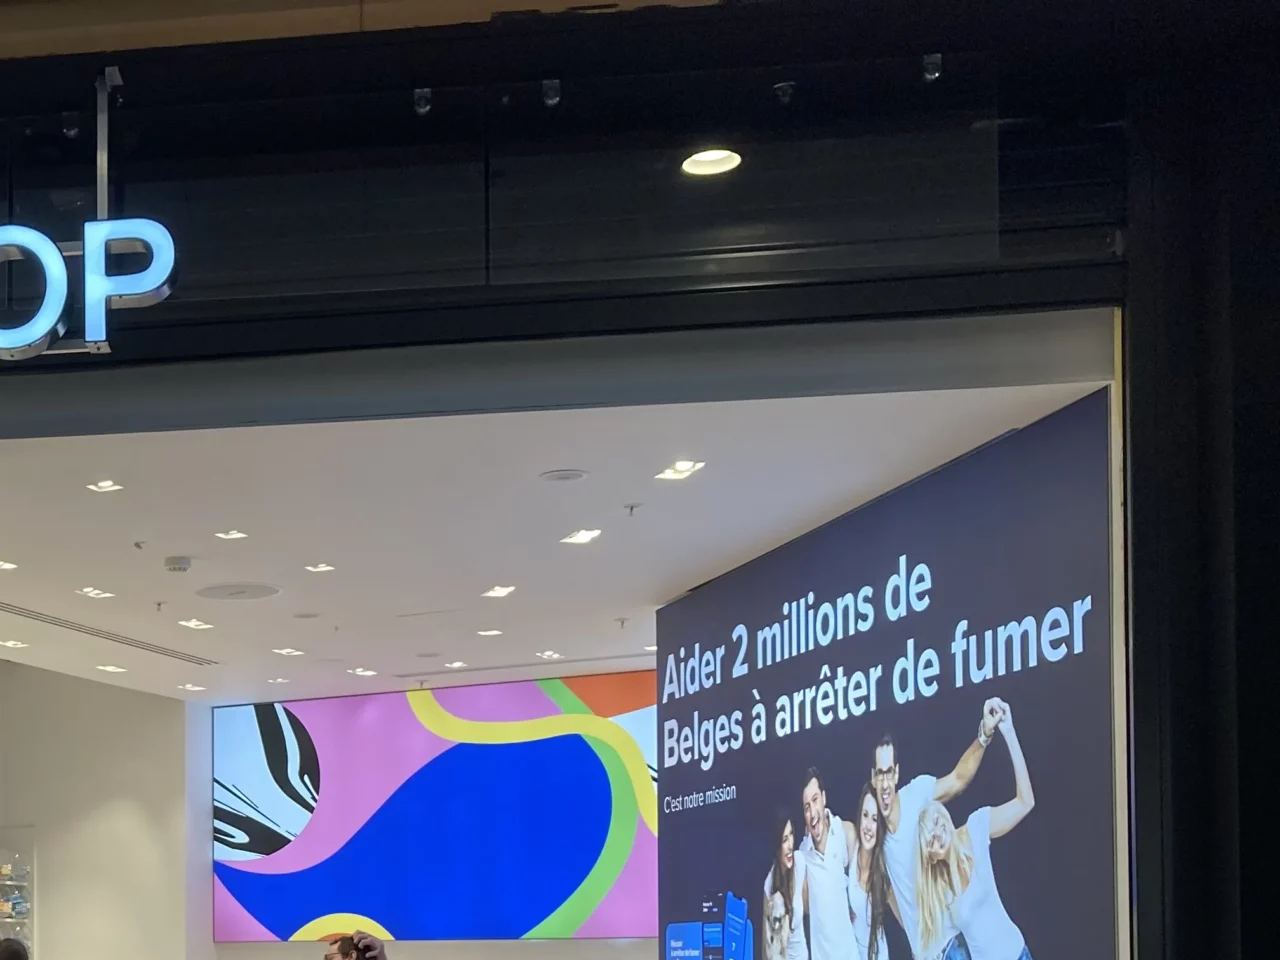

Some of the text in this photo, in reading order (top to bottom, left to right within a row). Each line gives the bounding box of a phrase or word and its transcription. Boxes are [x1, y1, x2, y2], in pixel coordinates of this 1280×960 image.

[662, 554, 932, 704] Aider 2 millions de
[663, 594, 1092, 771] Belges à arrêter de fumer
[663, 783, 737, 813] C'est notre mission
